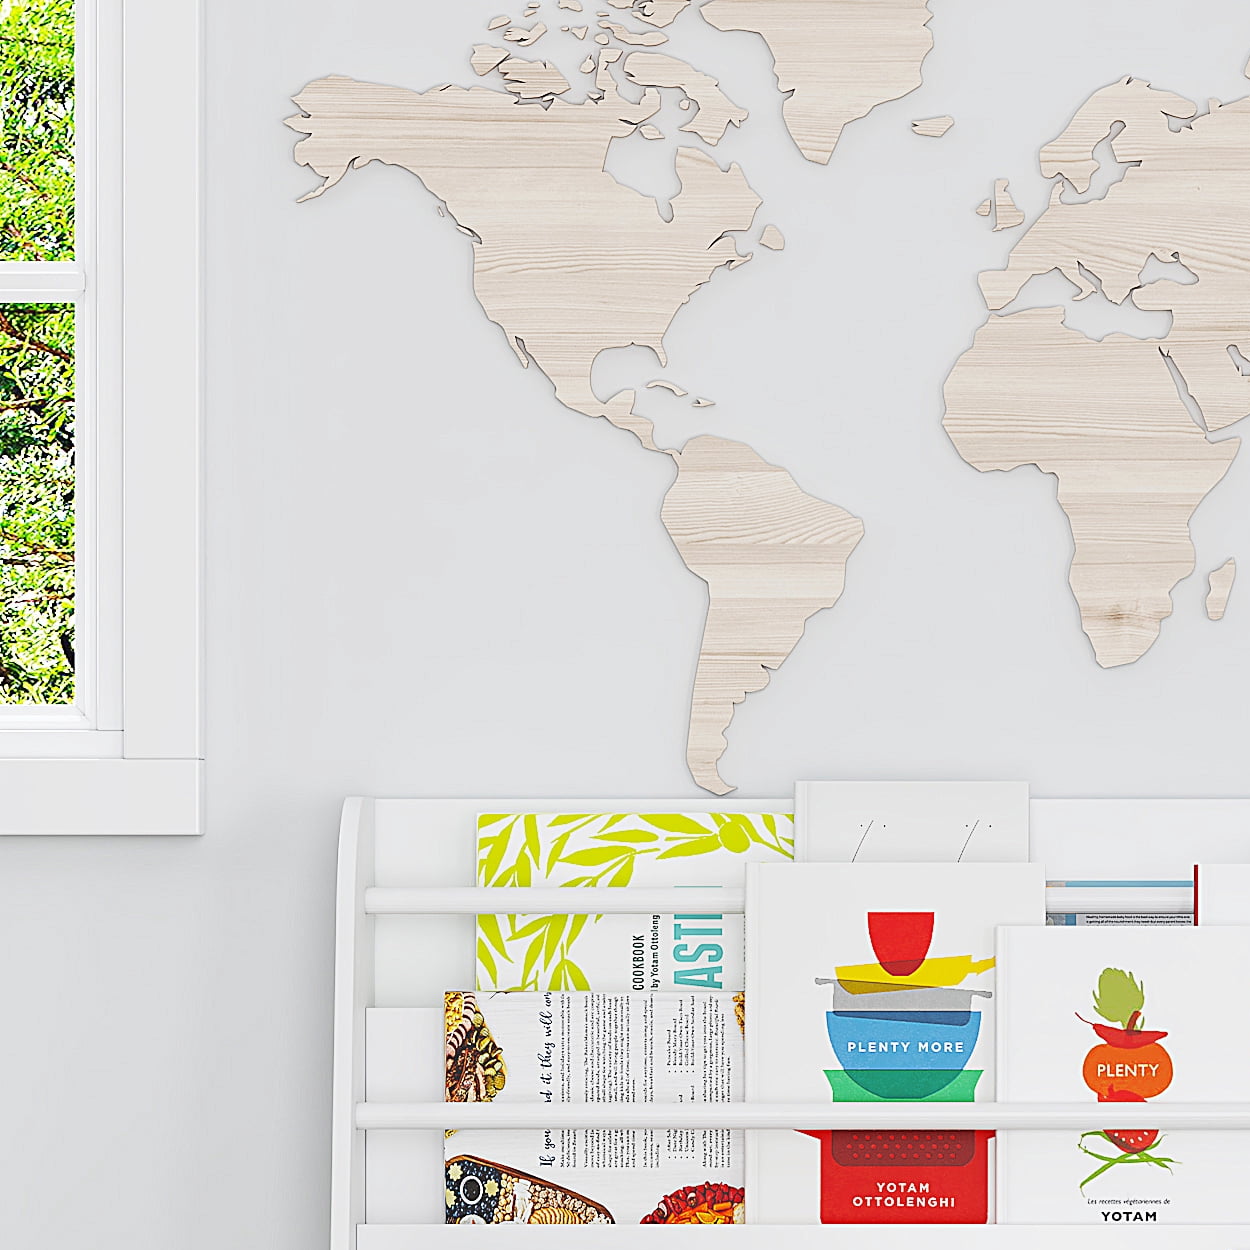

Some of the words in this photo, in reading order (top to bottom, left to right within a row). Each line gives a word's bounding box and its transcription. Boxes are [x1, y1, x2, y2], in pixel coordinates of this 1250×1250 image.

[650, 914, 660, 950] Ottoleng
[632, 935, 644, 991] COOKBOOK
[650, 951, 660, 977] Yotam
[650, 978, 660, 988] by
[538, 1011, 552, 1037] will
[847, 1042, 910, 1052] PLENTY
[918, 1042, 964, 1053] MORE
[537, 1042, 555, 1068] they
[1097, 1063, 1159, 1077] PLENTY
[538, 1154, 555, 1167] If
[876, 1182, 929, 1193] YOTAM
[852, 1196, 955, 1207] OTTOLENGHI
[1101, 1211, 1157, 1222] YOTAM
